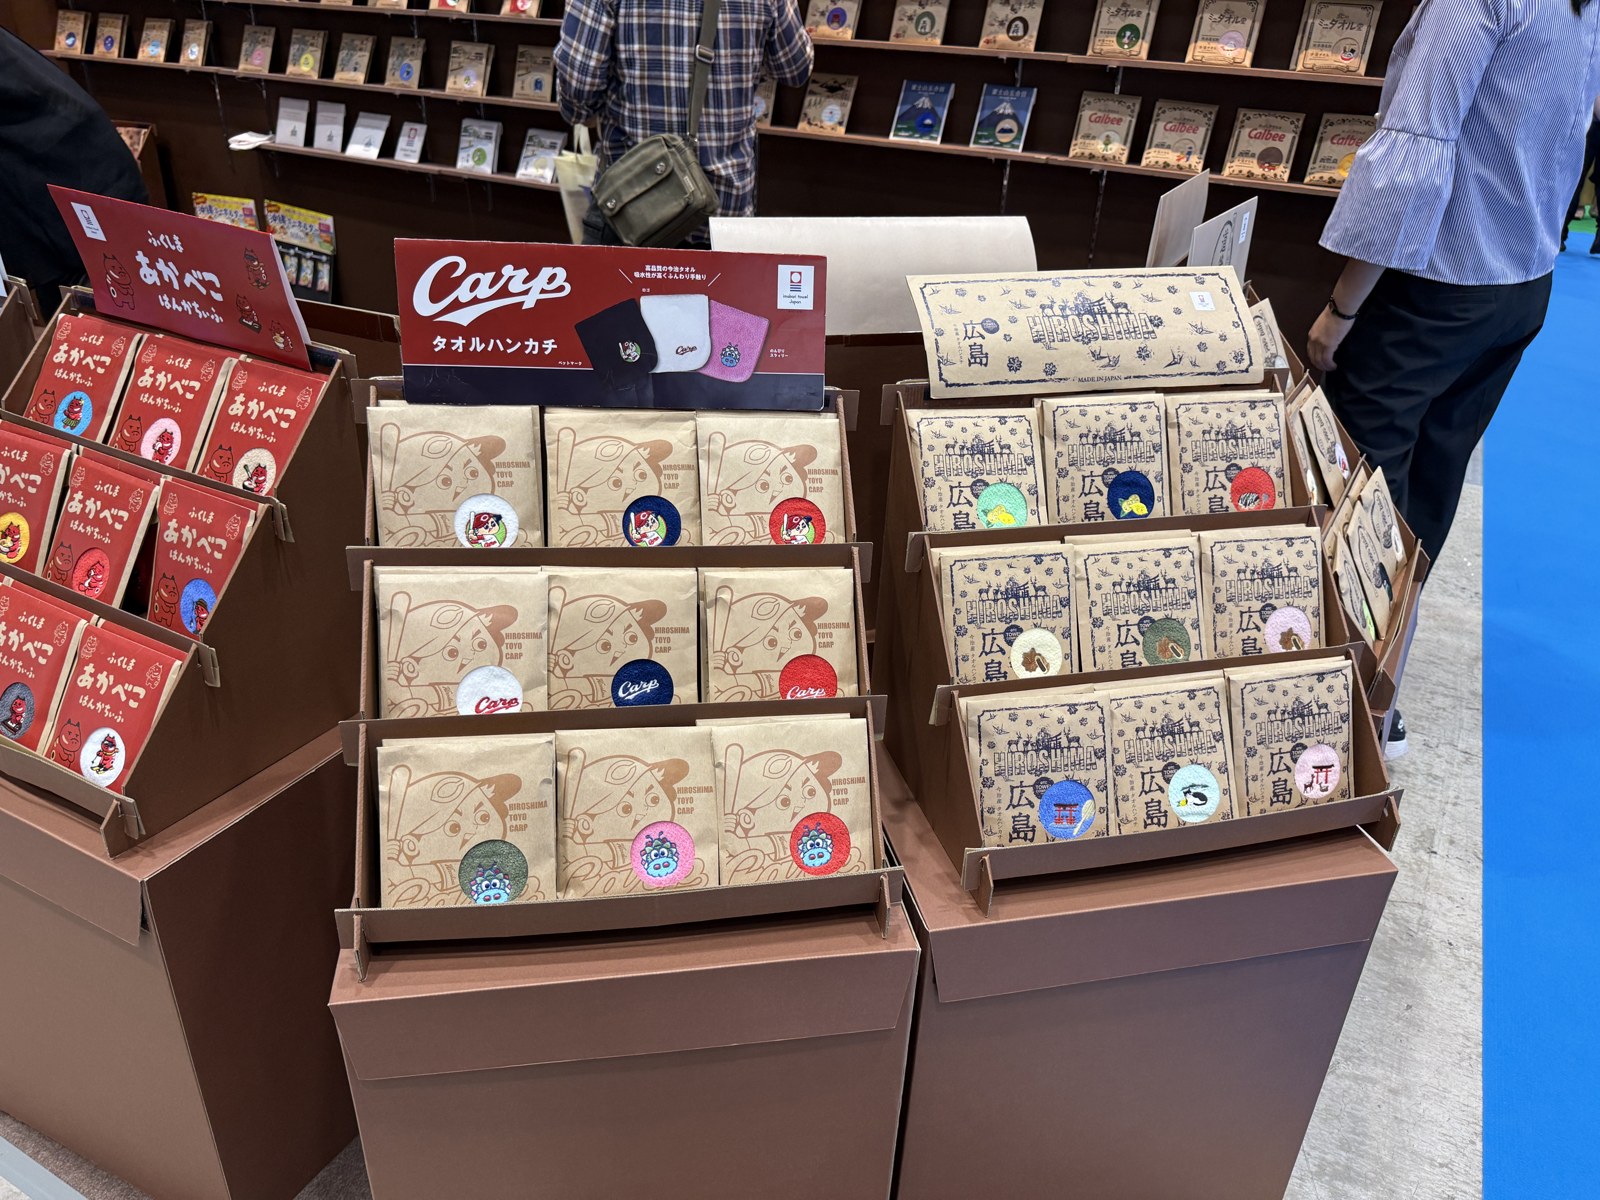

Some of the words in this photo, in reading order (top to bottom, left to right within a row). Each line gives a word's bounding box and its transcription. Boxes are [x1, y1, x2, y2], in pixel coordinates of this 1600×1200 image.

[1088, 112, 1123, 126] Calbee
[1163, 121, 1199, 134] Calbee
[1247, 127, 1286, 142] Calbee
[1330, 134, 1364, 147] Calbe
[147, 229, 184, 254] ふくしま
[135, 250, 223, 302] あかべこ
[633, 271, 707, 281] 吸水性が高くふんわり手触り
[645, 264, 696, 273] 高品質の今治タオル
[413, 255, 571, 326] Carp
[1027, 313, 1157, 343] HIROSHIMA
[79, 332, 104, 346] ふくしま
[432, 335, 558, 355] タオルハンカチ
[963, 320, 988, 367] 広島
[53, 343, 111, 374] あかべこ
[165, 355, 191, 369] ふくしま
[137, 365, 201, 400] あかべこ
[258, 381, 287, 396] ふくしま
[228, 393, 297, 429] あかべこ
[1, 446, 28, 462] ふくしま
[1068, 441, 1156, 467] HIROSHIMA
[1191, 437, 1276, 462] HIROSHIMA
[495, 461, 531, 469] HIROSHIMA
[807, 468, 838, 476] HIROSHIMA
[933, 453, 1028, 477] HIROSHIMA
[0, 463, 42, 494] かべこ
[94, 480, 121, 497] ふくしま
[67, 491, 130, 530] あかべこ
[188, 507, 215, 524] ふくしま
[163, 518, 228, 559] あかべこ
[1226, 576, 1313, 602] HIROSHIMA
[966, 595, 1062, 624] HIROSHIMA
[1101, 587, 1191, 616] HIROSHIMA
[18, 611, 46, 629] ふくしま
[505, 642, 522, 650] TOYO
[0, 652, 35, 678] んかちぃふ
[107, 652, 136, 671] ふくしま
[505, 652, 523, 660] CARP
[77, 662, 146, 708] あかべこ
[618, 679, 659, 700] Carp
[786, 686, 826, 700] Carp
[475, 696, 519, 715] Carp
[1256, 711, 1343, 745] HIROSHIMA
[1124, 730, 1217, 763] HIROSHIMA
[994, 746, 1097, 776] HIROSHIMA
[831, 776, 866, 786] HIROSHIMA
[1267, 748, 1293, 807] 広島
[676, 785, 714, 794] HIROSHIMA
[832, 788, 848, 796] TOYO
[1139, 766, 1168, 829] 広島
[508, 800, 548, 811] HIROSHIMA
[677, 807, 695, 815] CARP
[833, 798, 850, 806] CARP
[509, 813, 527, 822] TOYO
[1005, 781, 1036, 843] 広島
[509, 824, 528, 832] CARP
